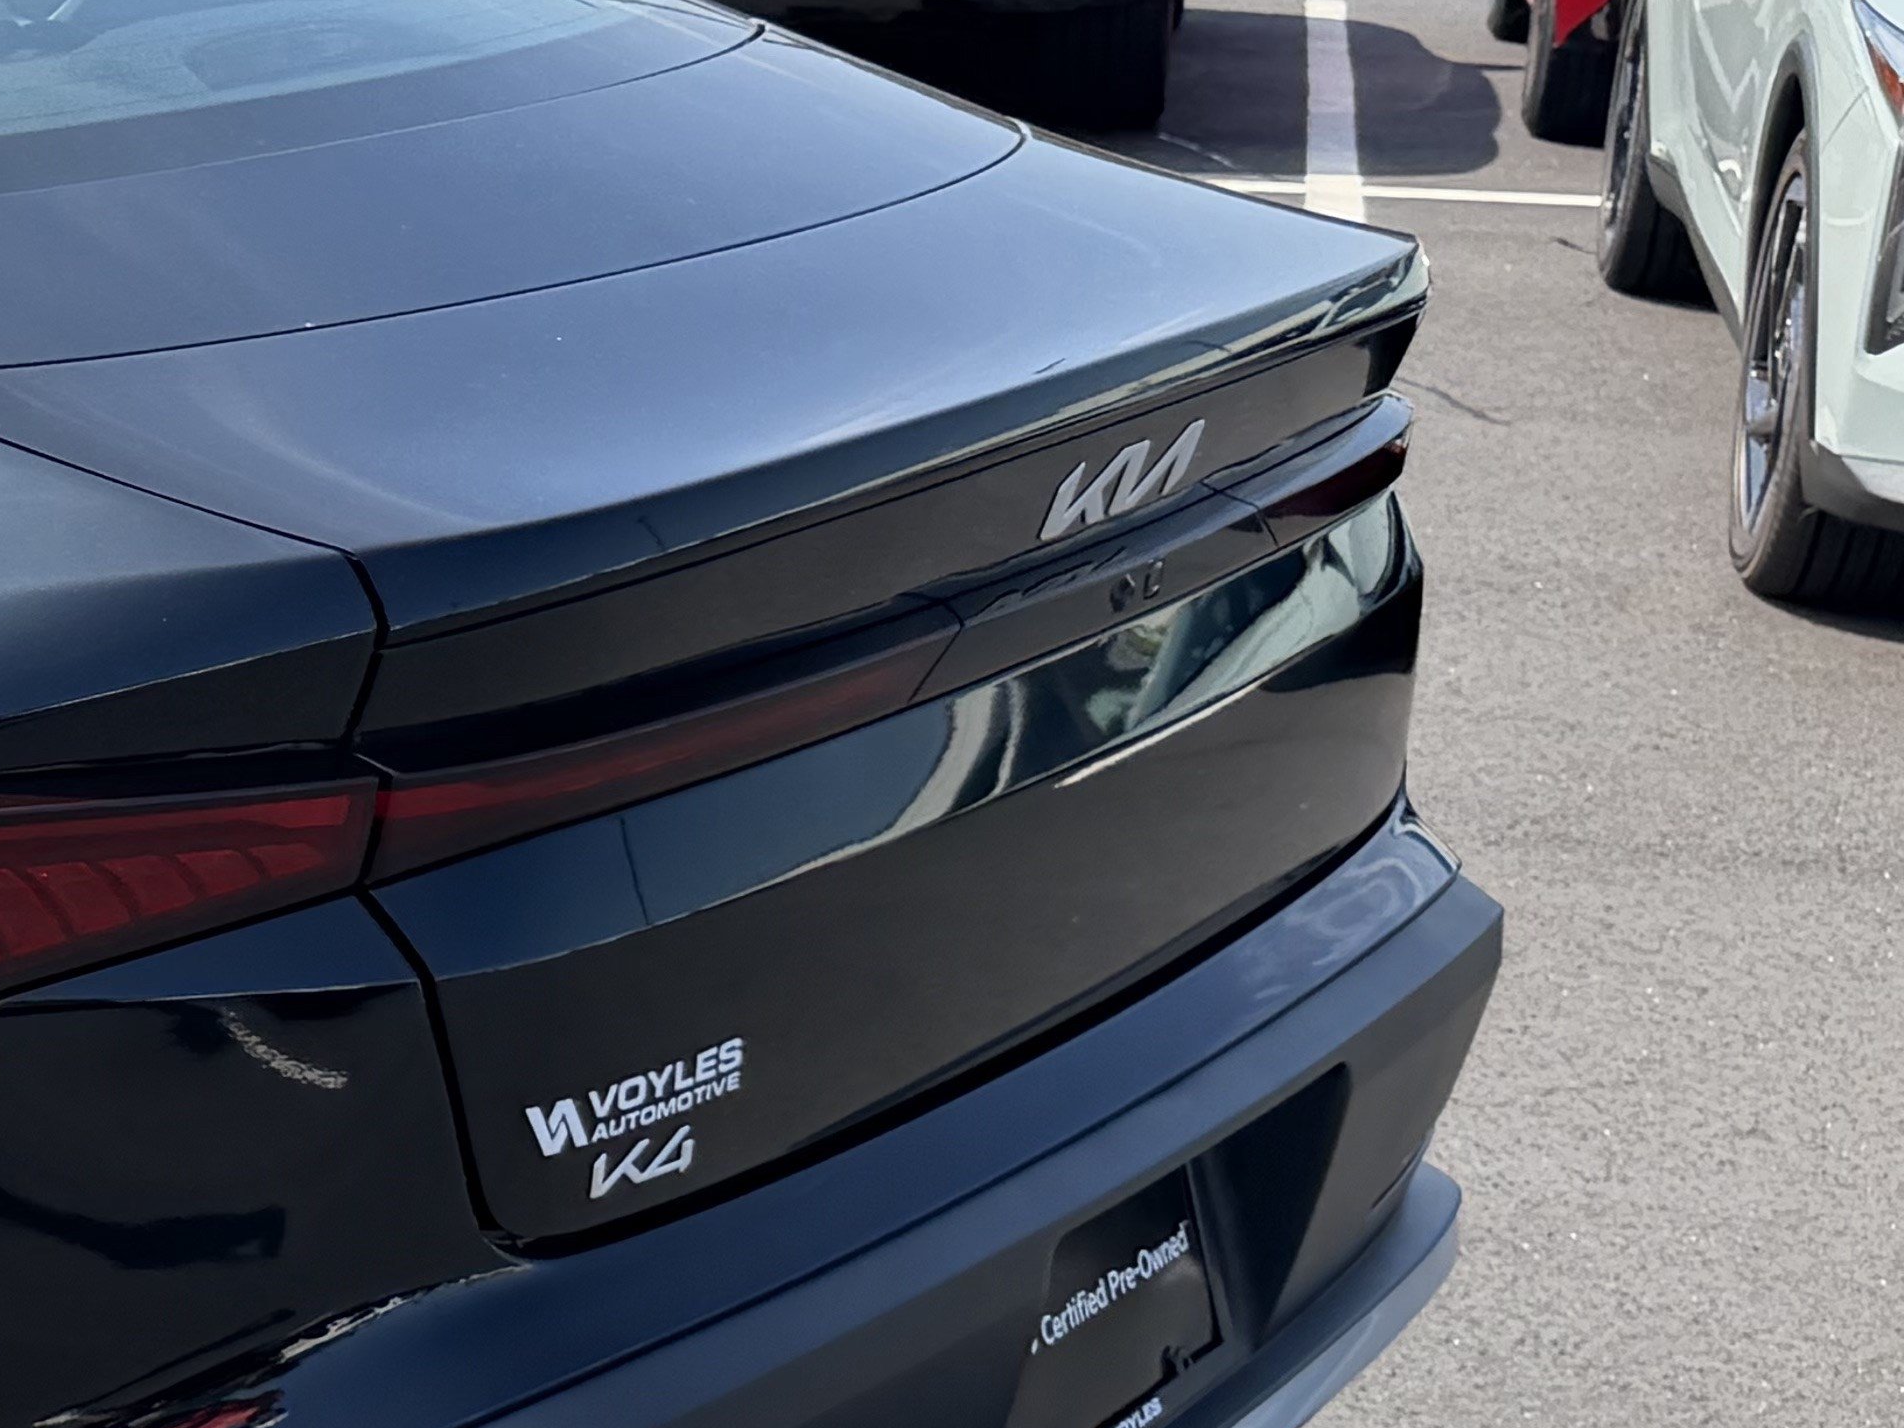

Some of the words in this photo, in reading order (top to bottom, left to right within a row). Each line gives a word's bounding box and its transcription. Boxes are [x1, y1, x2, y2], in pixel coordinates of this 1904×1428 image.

[1039, 418, 1205, 540] KIA
[589, 1037, 744, 1118] VOYLES
[592, 1071, 741, 1143] AUTOMOTIVE
[590, 1125, 695, 1199] K4
[1040, 1277, 1109, 1345] Certified
[1107, 1222, 1188, 1301] Pre-Owned
